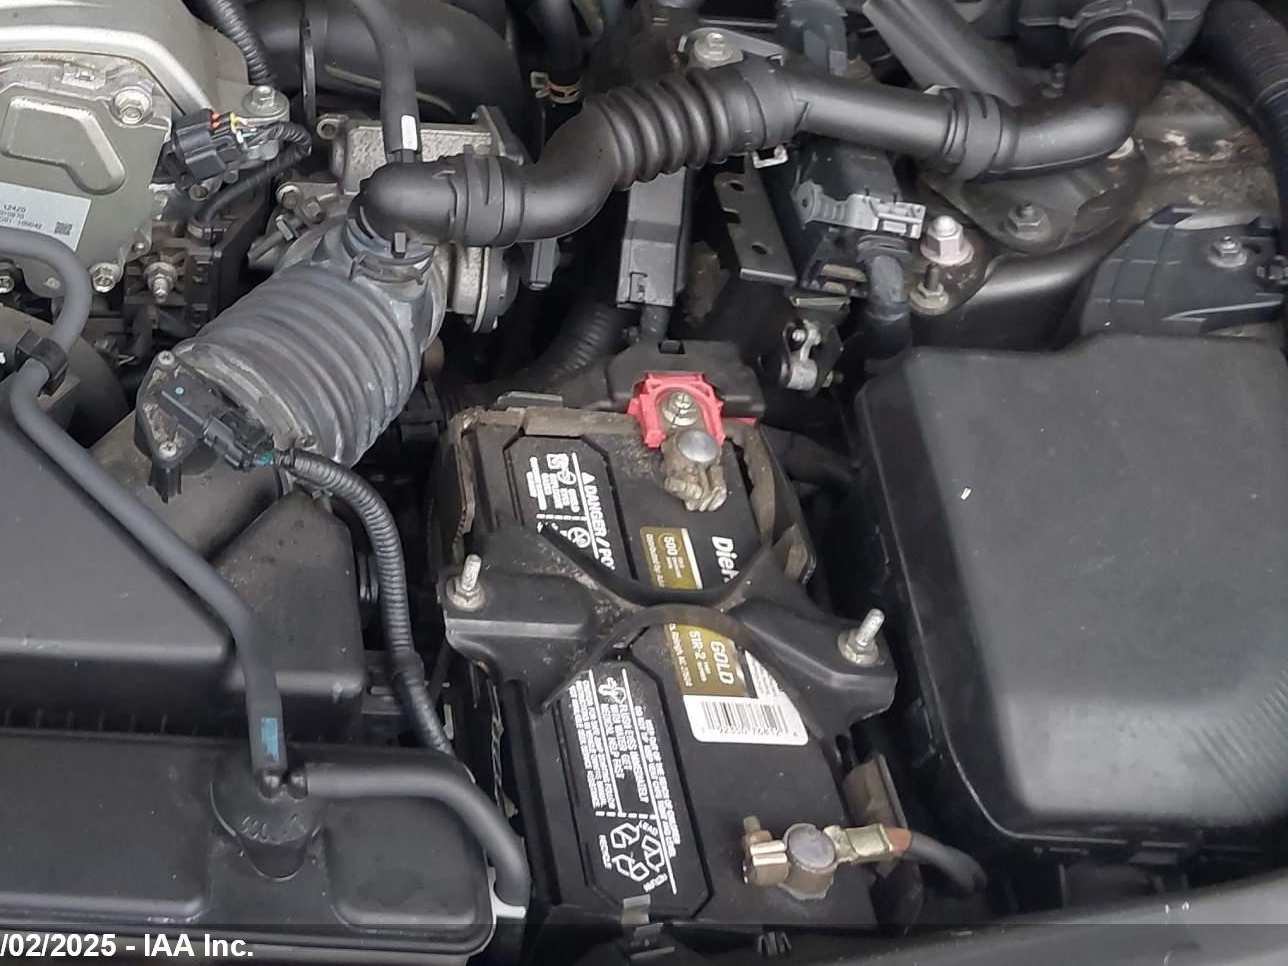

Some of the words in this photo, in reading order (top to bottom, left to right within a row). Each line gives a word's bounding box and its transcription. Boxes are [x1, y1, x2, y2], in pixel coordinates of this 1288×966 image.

[583, 486, 615, 569] DANGER/PO
[663, 536, 677, 555] 500
[709, 640, 735, 683] GOLD
